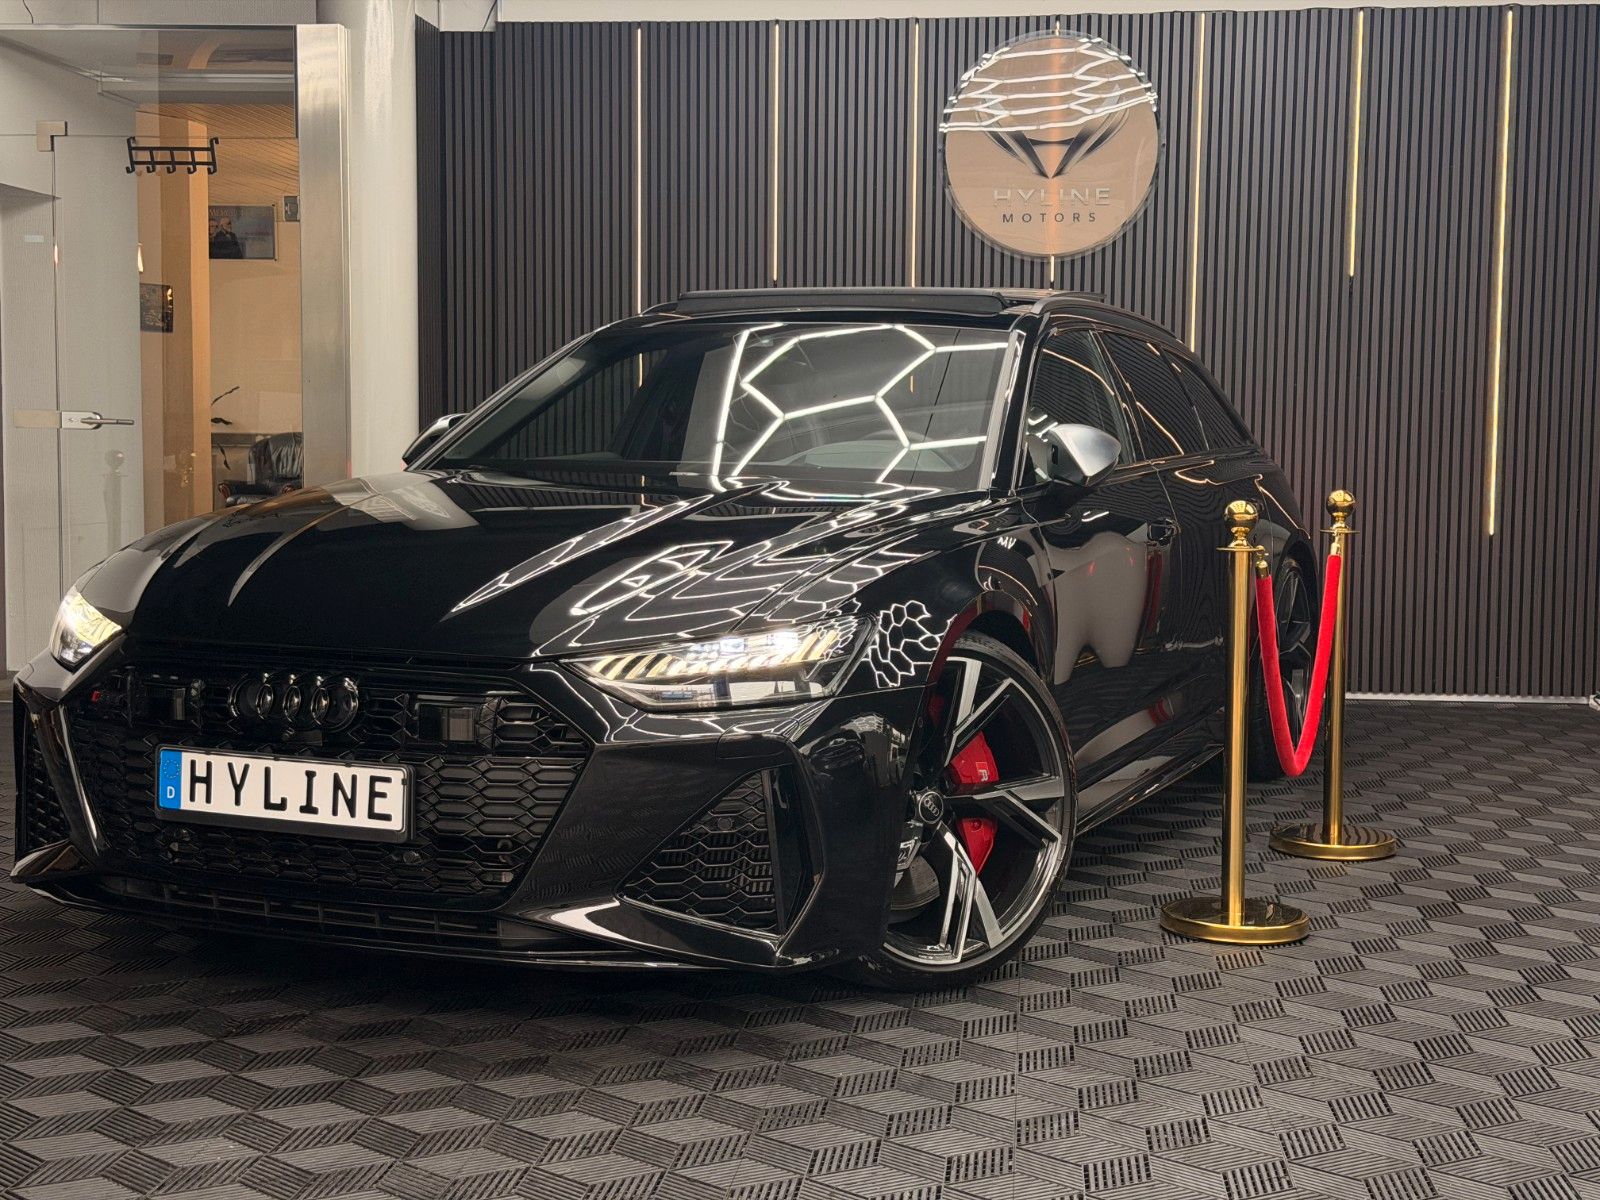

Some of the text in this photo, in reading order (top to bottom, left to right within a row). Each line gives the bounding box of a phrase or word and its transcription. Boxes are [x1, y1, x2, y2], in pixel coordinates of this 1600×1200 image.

[993, 188, 1110, 206] HYLINE
[1002, 212, 1096, 223] MOTORS
[166, 786, 176, 799] D
[189, 759, 393, 822] HYLINE
